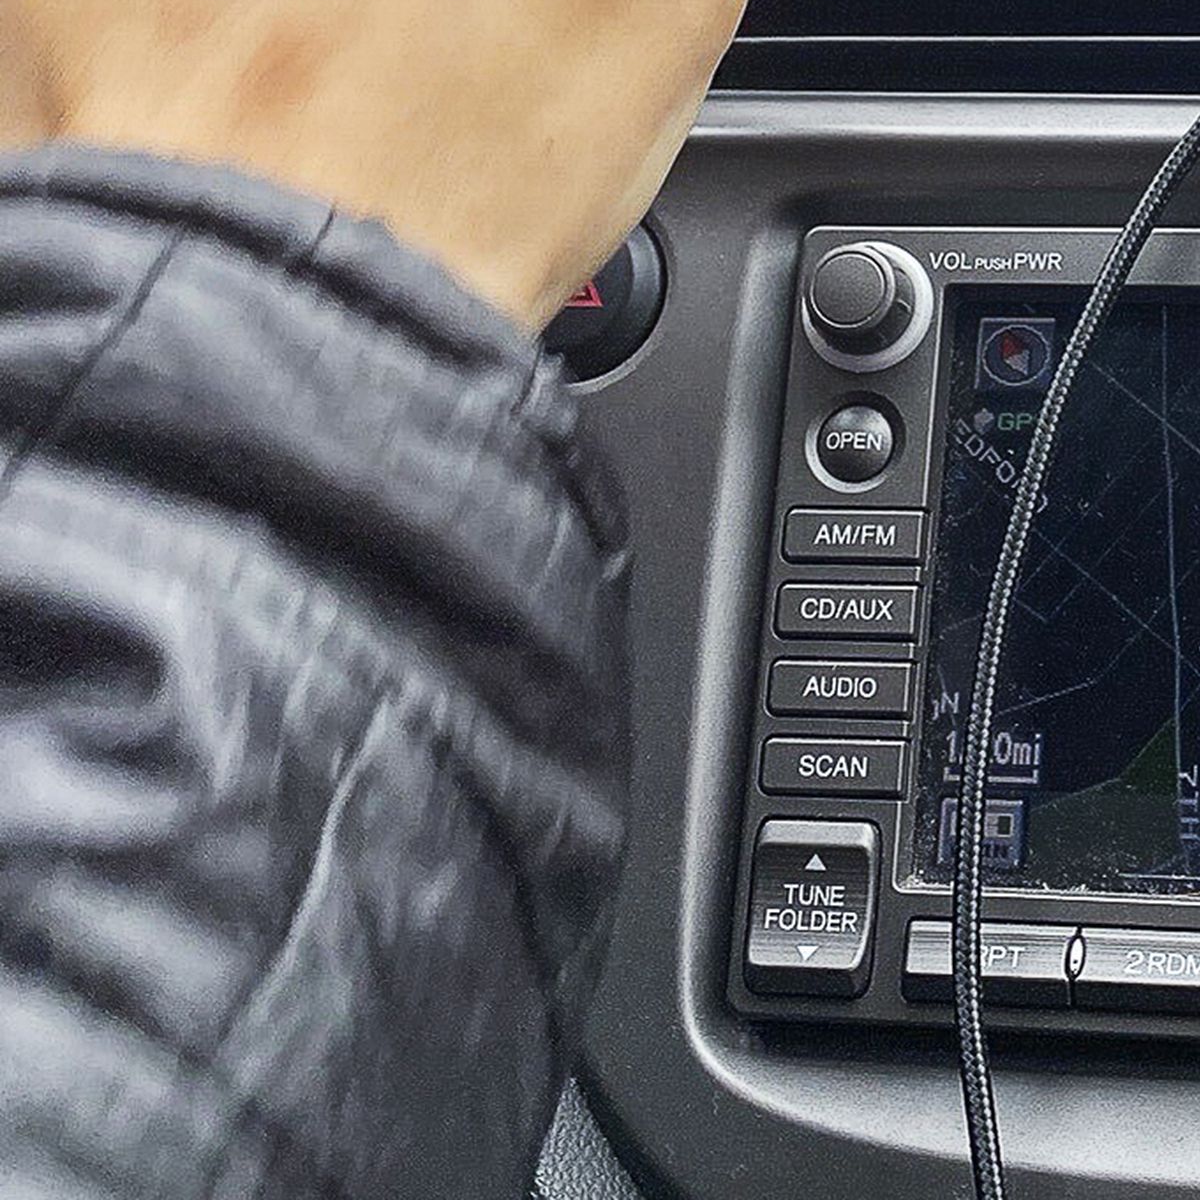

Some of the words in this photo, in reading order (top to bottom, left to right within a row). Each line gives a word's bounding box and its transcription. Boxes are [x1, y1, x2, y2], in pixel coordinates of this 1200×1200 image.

[929, 252, 973, 271] VOL
[974, 257, 1013, 270] PUSH
[1014, 252, 1063, 271] PWR
[825, 432, 883, 451] OPEN
[814, 524, 896, 546] AM/FM
[800, 598, 893, 621] CD/AUX
[803, 676, 877, 698] AUDIO
[799, 755, 868, 778] SCAN
[784, 883, 845, 906] TUNE
[764, 908, 858, 932] FOLDER
